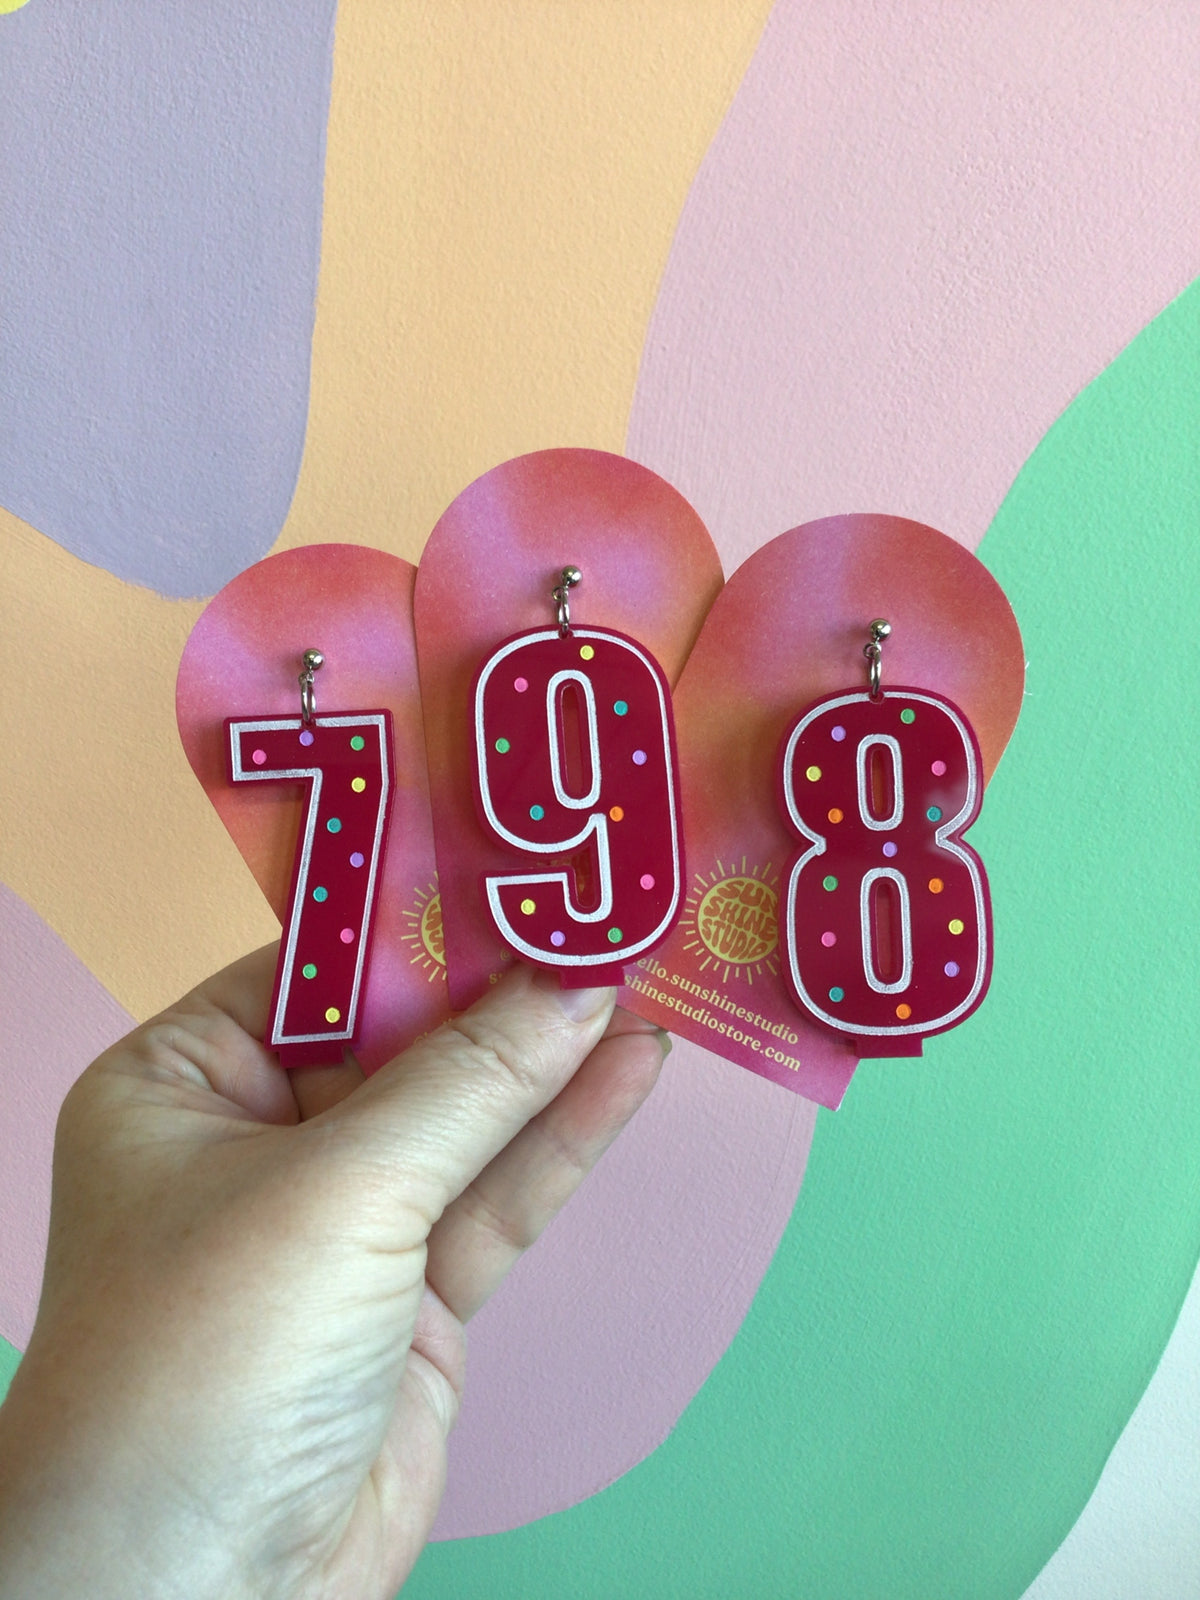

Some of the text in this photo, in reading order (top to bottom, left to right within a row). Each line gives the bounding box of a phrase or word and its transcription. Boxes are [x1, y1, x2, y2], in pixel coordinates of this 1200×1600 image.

[229, 714, 389, 1045] 7
[474, 629, 680, 967] 9
[783, 691, 988, 1035] 8
[633, 958, 799, 1045] ello.sunshinestudio
[701, 918, 768, 960] STUDIO
[703, 896, 777, 942] SHINE
